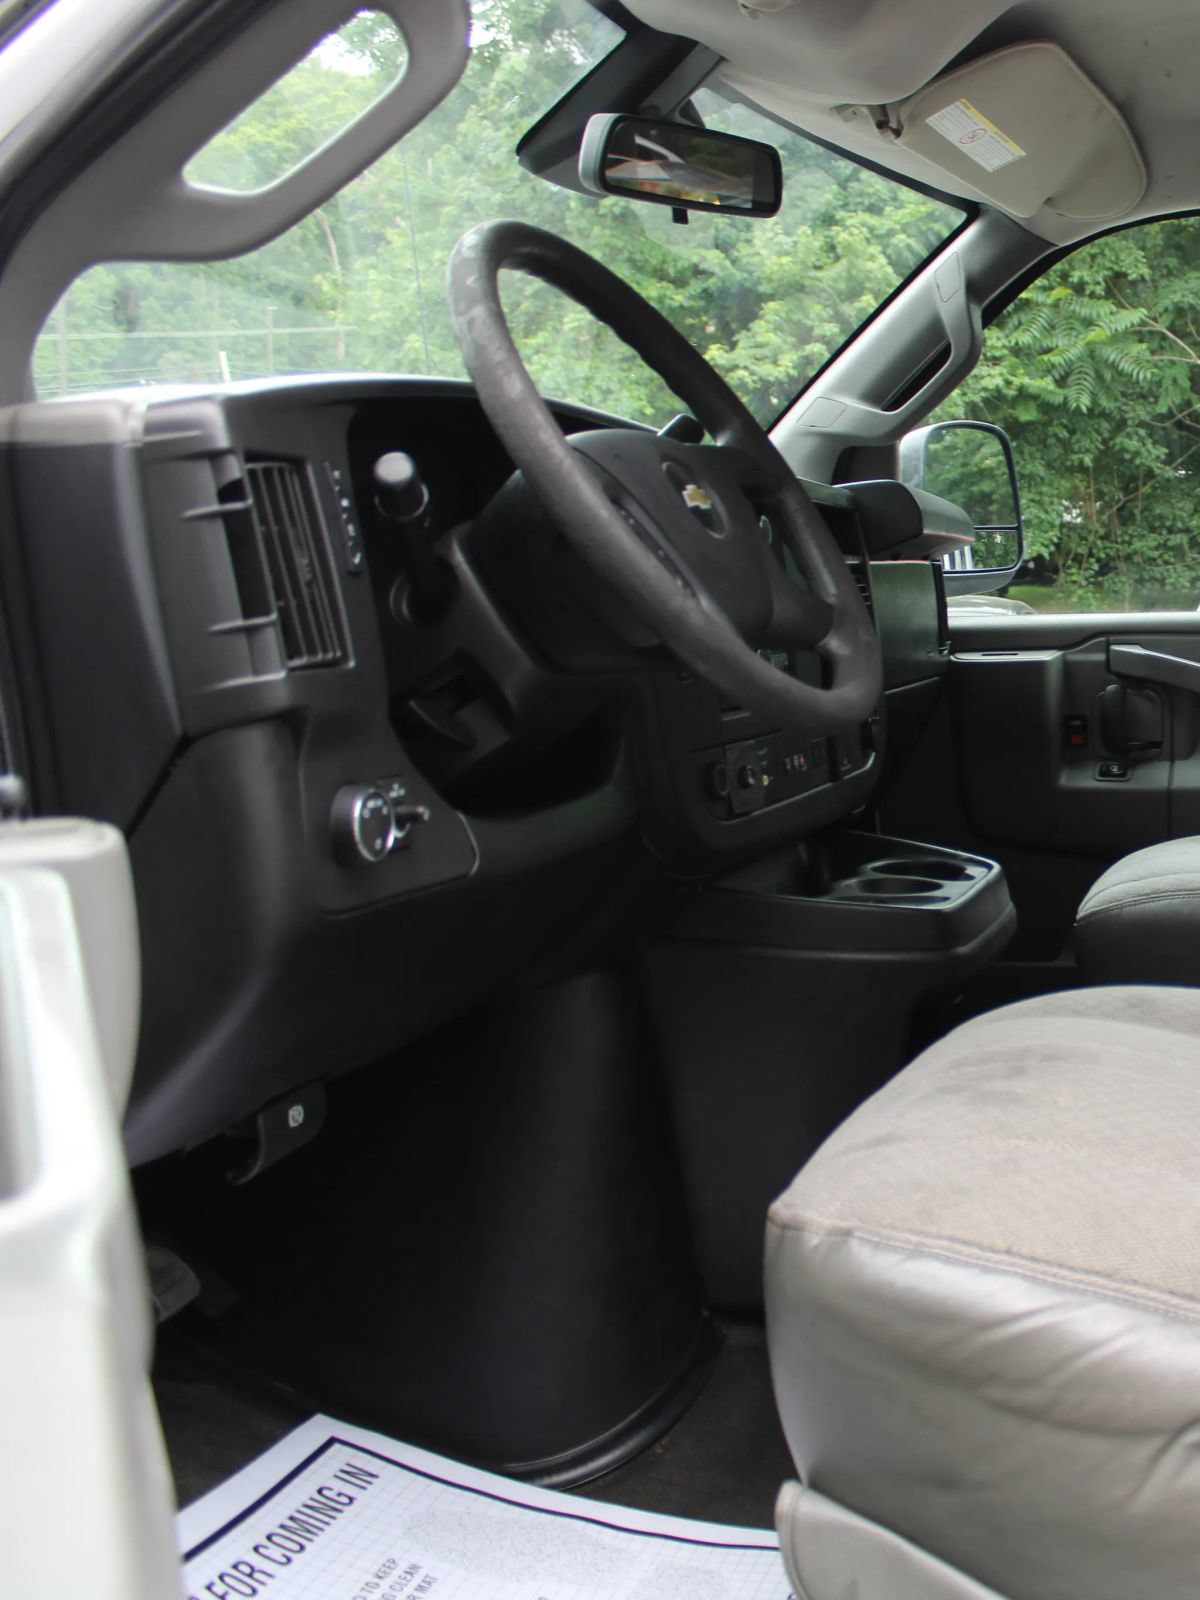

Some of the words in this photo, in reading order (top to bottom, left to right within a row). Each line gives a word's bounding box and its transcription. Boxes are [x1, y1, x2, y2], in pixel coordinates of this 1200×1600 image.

[204, 1561, 275, 1600] FOR
[252, 1486, 357, 1566] COMING
[333, 1463, 380, 1491] IN
[360, 1581, 381, 1594] TO
[372, 1558, 399, 1580] KEEP
[389, 1563, 423, 1592] CLEAN
[414, 1574, 439, 1594] MAT
